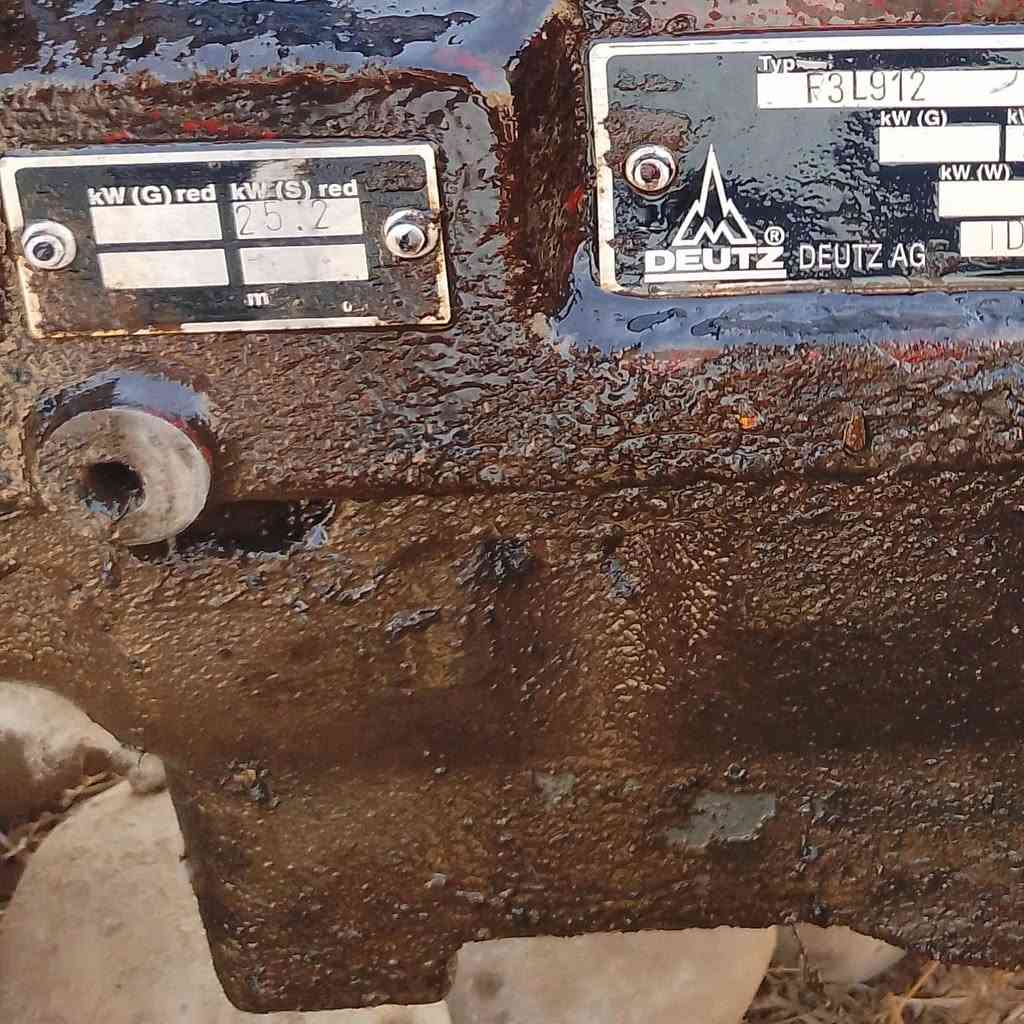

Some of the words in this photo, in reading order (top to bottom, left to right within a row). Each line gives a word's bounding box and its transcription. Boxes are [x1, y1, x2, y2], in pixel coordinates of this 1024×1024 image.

[758, 55, 796, 73] Typ
[807, 70, 926, 104] F3L912
[880, 109, 911, 126] kW
[917, 108, 948, 127] (G)
[940, 164, 971, 181] kW
[977, 163, 1011, 182] (W)
[87, 186, 126, 206] kW
[131, 184, 173, 206] (G)
[176, 183, 217, 202] red
[229, 182, 268, 201] kW
[275, 180, 312, 201] (S)
[318, 178, 359, 197] red
[644, 246, 785, 273] DEUTZ
[800, 242, 883, 269] DEUTZ
[891, 242, 926, 267] AG
